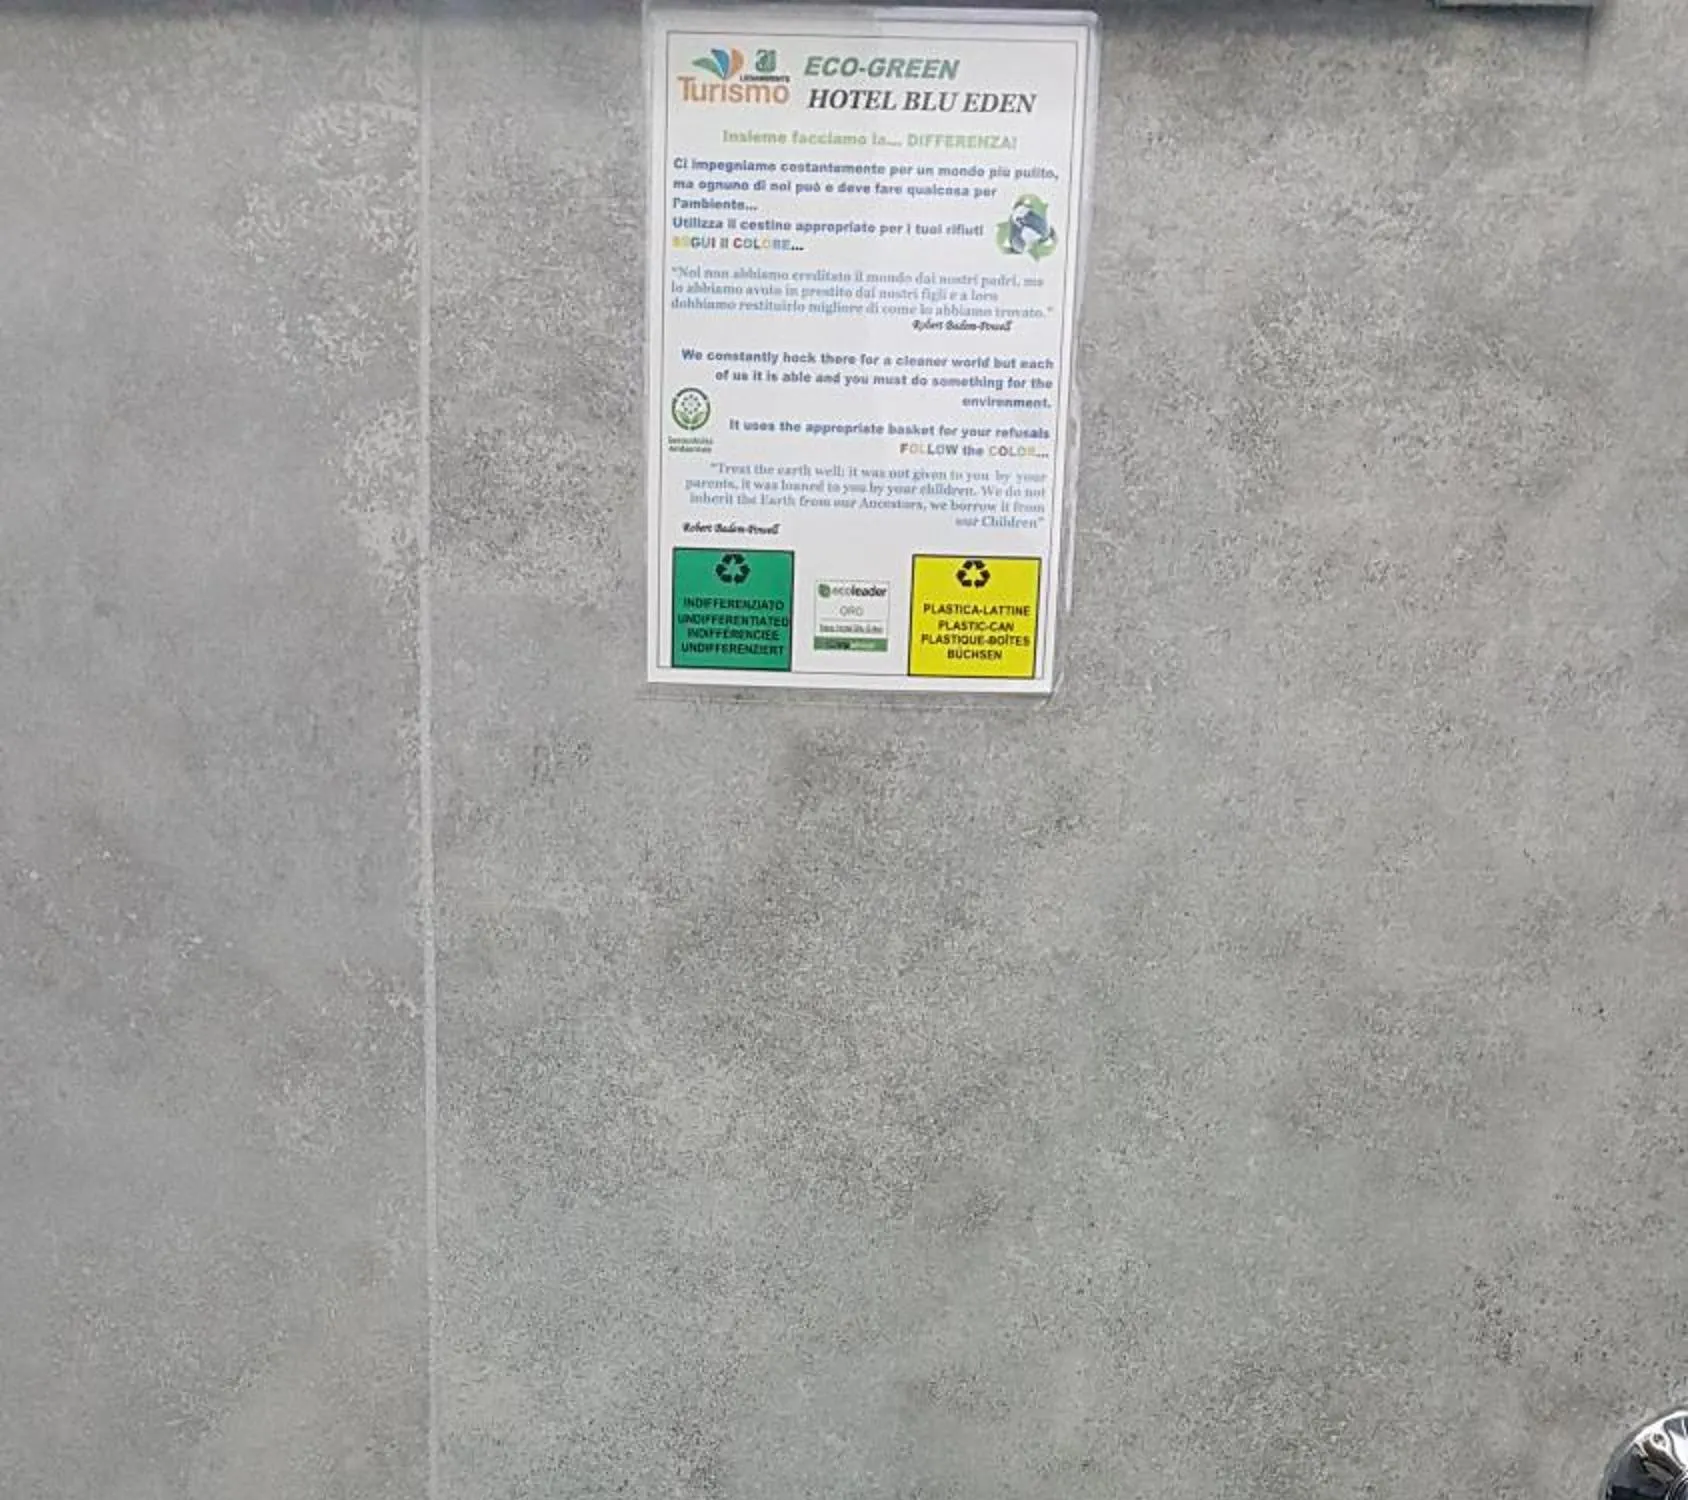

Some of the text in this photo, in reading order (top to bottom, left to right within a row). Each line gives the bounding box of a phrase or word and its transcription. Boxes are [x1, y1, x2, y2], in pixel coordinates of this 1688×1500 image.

[804, 55, 960, 80] ECO-GREEN
[677, 76, 789, 104] Turismo
[808, 88, 1037, 113] HOTEL BLU EDEN
[722, 130, 787, 144] Insieme
[793, 130, 866, 145] facciamo
[673, 158, 687, 169] Ci
[692, 159, 776, 173] impegniamo
[781, 162, 884, 175] costantemente
[890, 165, 912, 176] per
[917, 165, 934, 175] un
[938, 166, 984, 177] mondo
[673, 180, 693, 189] ma
[698, 180, 748, 192] ognuno
[754, 180, 766, 190] di
[770, 181, 791, 191] noi
[825, 184, 833, 192] e
[838, 182, 875, 193] deve
[876, 183, 902, 194] fare
[907, 184, 969, 197] qualcosa
[974, 187, 996, 198] per
[673, 217, 722, 229] Utilizza
[728, 218, 736, 228] il
[740, 219, 792, 230] cestino
[796, 220, 876, 233] appropriato
[880, 223, 902, 235] per
[916, 223, 941, 235] tuoi
[946, 223, 983, 236] rifiuti
[704, 268, 729, 279] non
[734, 267, 790, 280] abbiamo
[867, 272, 912, 283] mondo
[939, 273, 978, 285] nostri
[686, 283, 743, 295] abbiamo
[879, 288, 918, 299] nostri
[671, 298, 736, 309] dobbiamo
[739, 299, 806, 312] restituirlo
[936, 305, 992, 317] abbiamo
[681, 349, 702, 360] We
[707, 350, 779, 364] constantly
[783, 351, 816, 363] hock
[821, 353, 856, 365] there
[861, 353, 878, 366] for
[896, 356, 947, 367] cleaner
[951, 356, 989, 368] world
[994, 357, 1016, 369] but
[1020, 358, 1054, 369] each
[716, 370, 1053, 390] of us it is able and you must do something for the
[729, 420, 1050, 439] It uses the appropriate basket for your refusals
[963, 445, 984, 456] the
[754, 463, 774, 474] the
[777, 464, 811, 476] earth
[861, 469, 885, 478] was
[913, 469, 947, 482] given
[1016, 473, 1047, 483] your
[754, 481, 778, 490] was
[887, 484, 917, 496] your
[690, 493, 733, 505] inherit
[737, 493, 756, 505] the
[760, 494, 796, 506] Earth
[799, 495, 831, 507] from
[930, 502, 946, 511] we
[950, 500, 997, 512] borrow
[1013, 501, 1045, 513] from
[832, 584, 886, 597] ecoleader
[684, 599, 784, 610] INDIFFERENZIATO
[923, 603, 1031, 617] PLASTICA-LATTINE
[678, 614, 789, 627] UNDIFFERENTIATED
[938, 620, 1014, 632] PLASTIC-CAN
[681, 643, 783, 656] UNDIFFERENZIERT
